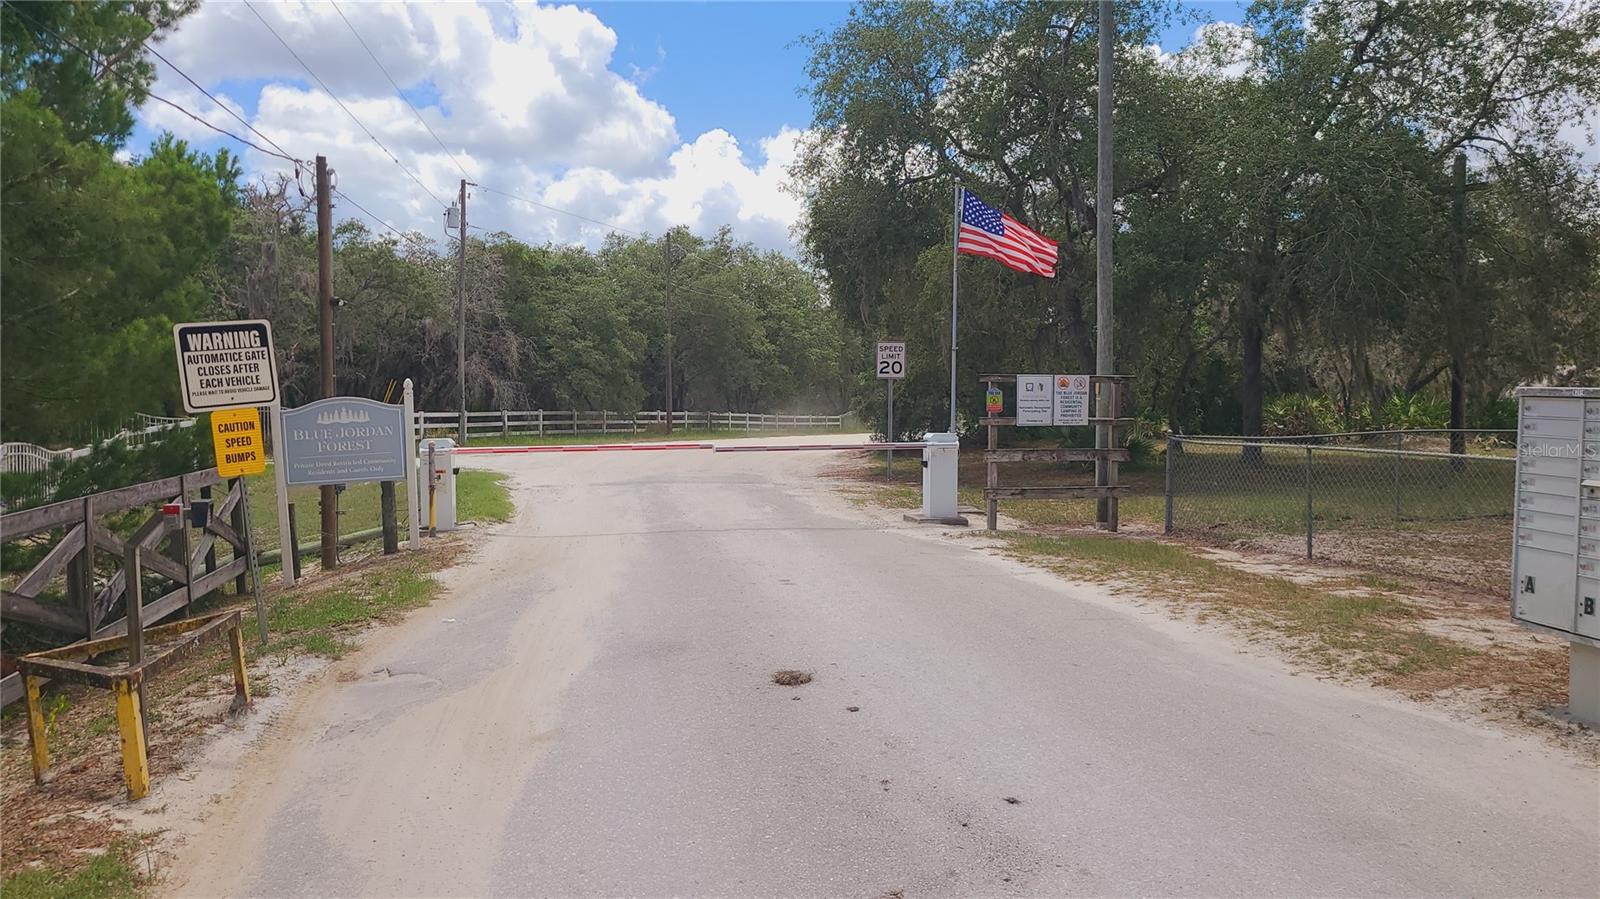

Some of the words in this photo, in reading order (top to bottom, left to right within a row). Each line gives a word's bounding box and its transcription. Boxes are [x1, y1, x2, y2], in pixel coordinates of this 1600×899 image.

[187, 330, 261, 351] WARNING
[187, 351, 244, 365] AUTOMATICE
[244, 350, 267, 361] GATE
[197, 364, 231, 377] CLOSES
[233, 362, 260, 374] AFTER
[879, 361, 903, 374] 20
[199, 378, 224, 389] EACH
[225, 374, 261, 387] VEHICLE
[218, 420, 255, 433] CAUTION
[294, 429, 332, 440] BLUE
[335, 425, 394, 438] JORDAN
[225, 436, 252, 448] SPEED
[318, 440, 373, 452] FOREST
[225, 451, 256, 464] BUMPS
[293, 461, 315, 469] Private
[316, 459, 332, 467] Deed
[333, 457, 363, 466] Restricted
[363, 457, 397, 466] Community
[307, 467, 335, 476] Residents
[348, 466, 369, 474] Guests
[369, 465, 384, 474] Only
[1524, 575, 1535, 594] A
[1584, 596, 1595, 616] B
